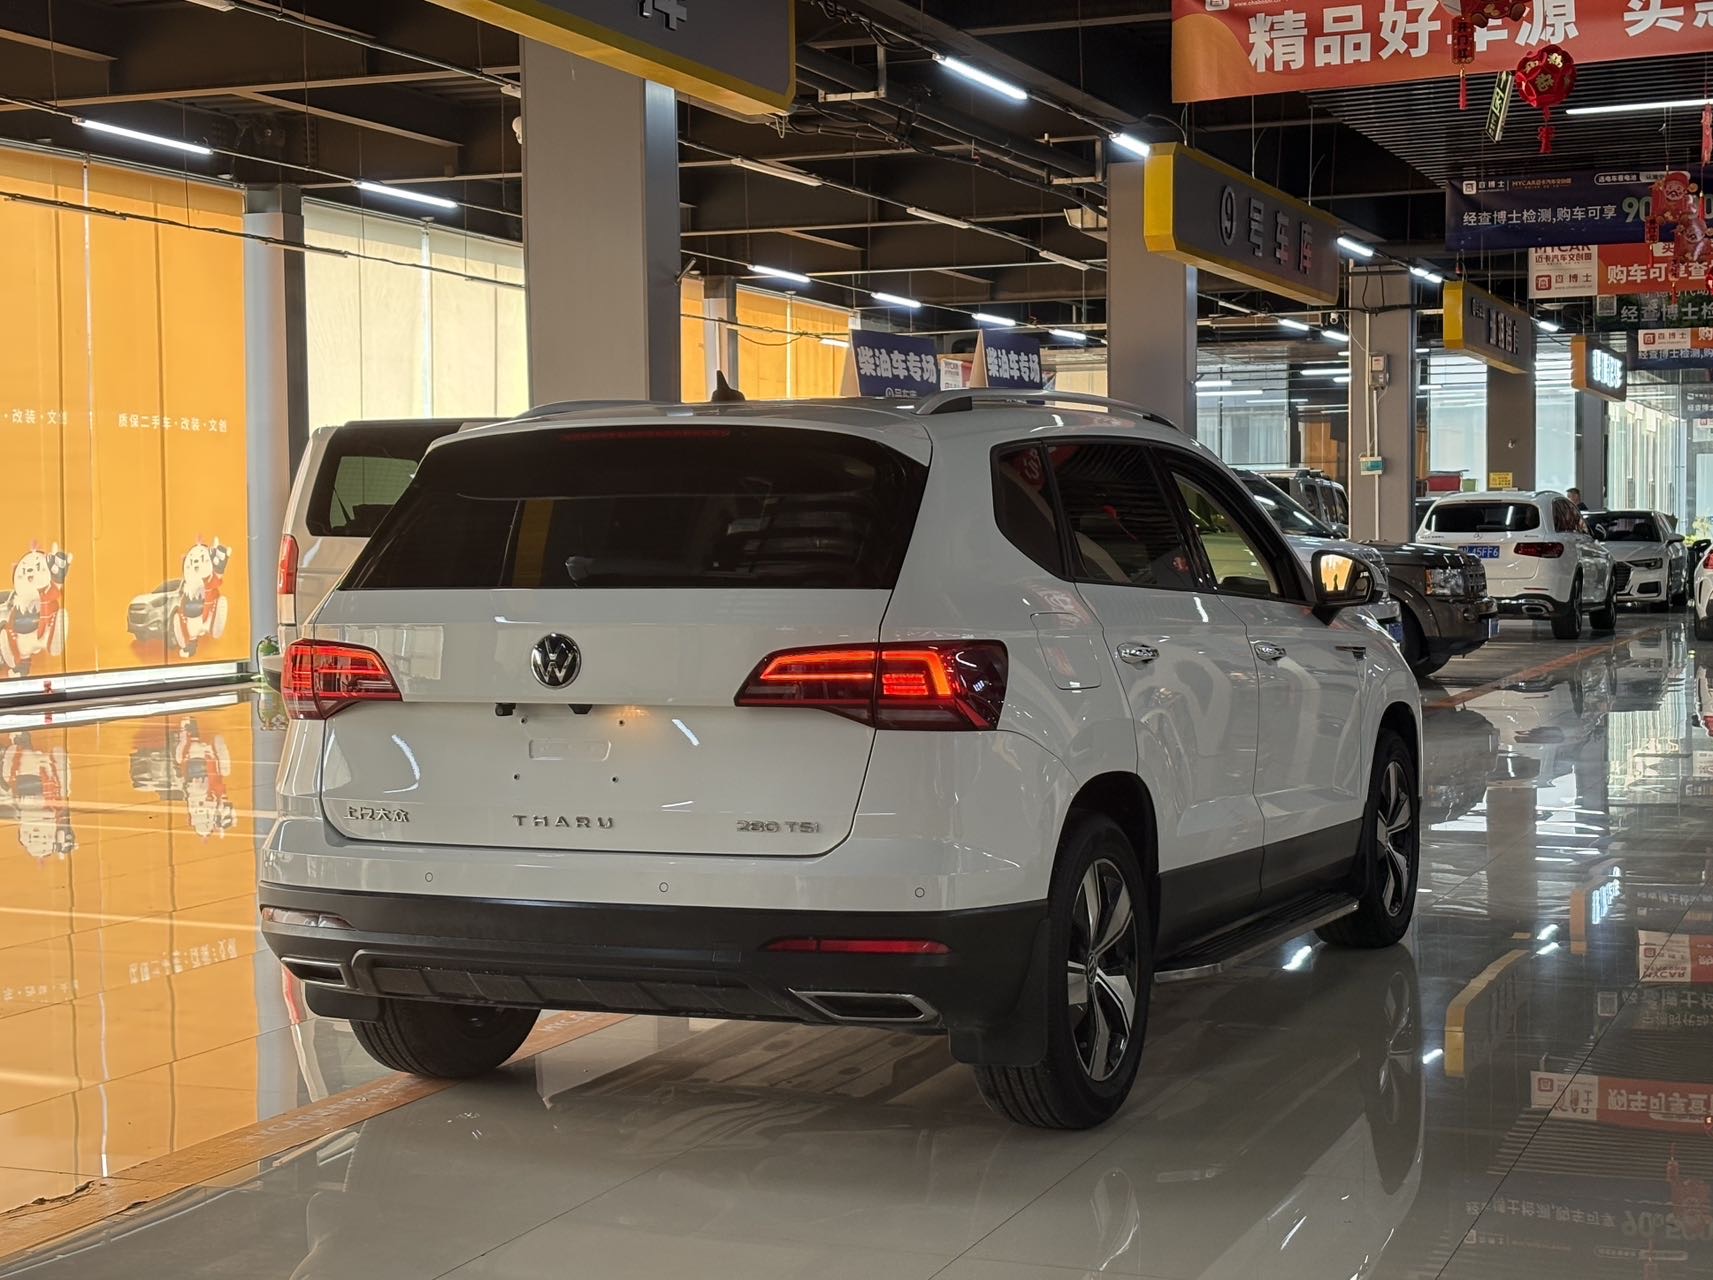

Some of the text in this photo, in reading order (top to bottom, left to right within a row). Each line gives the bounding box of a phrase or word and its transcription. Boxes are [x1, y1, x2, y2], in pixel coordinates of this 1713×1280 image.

[857, 345, 937, 384] 柴油车专场
[512, 813, 615, 831] THARU
[736, 820, 779, 833] 280
